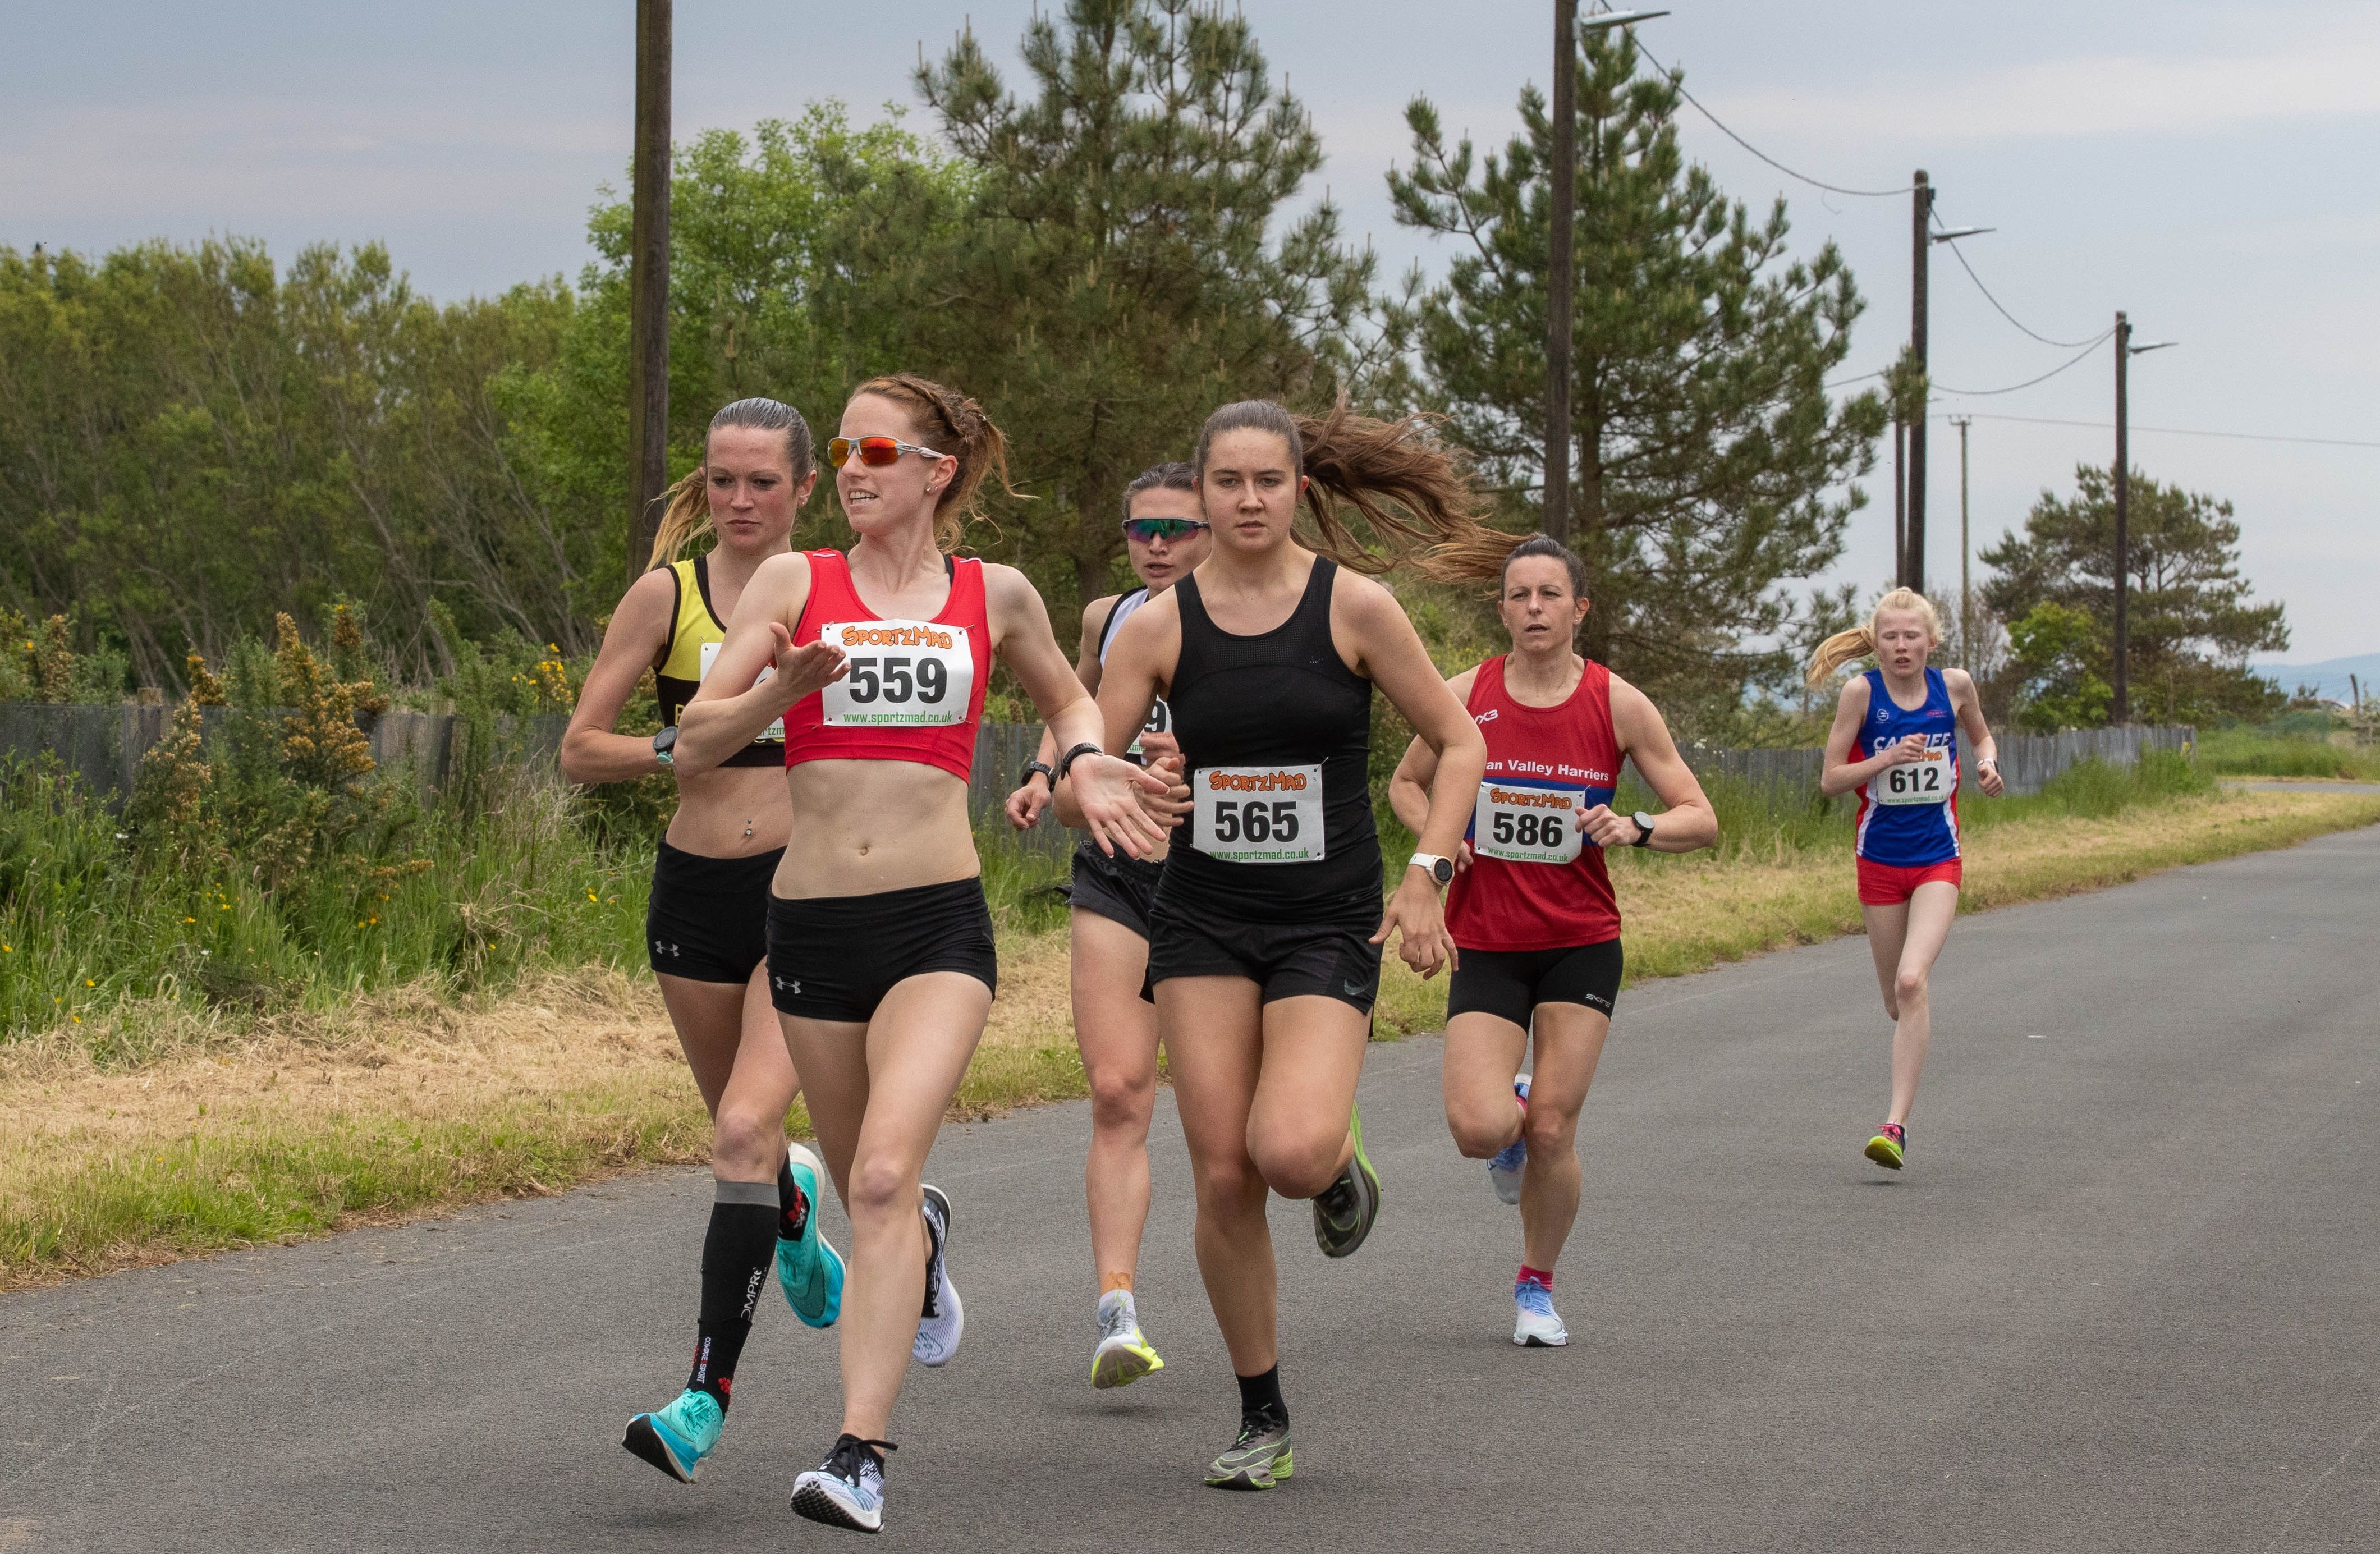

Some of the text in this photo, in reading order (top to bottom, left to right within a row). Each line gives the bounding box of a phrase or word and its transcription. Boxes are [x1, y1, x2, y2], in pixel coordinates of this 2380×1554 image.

[849, 657, 947, 704] 559
[843, 710, 952, 725] www.sportzmad.co.uk
[1873, 732, 1951, 750] CAIFF
[1507, 759, 1554, 776] Valley
[1558, 764, 1609, 781] Harriers
[1890, 767, 1939, 794] 612
[1215, 801, 1299, 842] 565
[1493, 811, 1563, 847] 586
[1209, 847, 1309, 861] www.sportzmad.co.uk
[1488, 846, 1568, 863] www.sportzmad.co.uk
